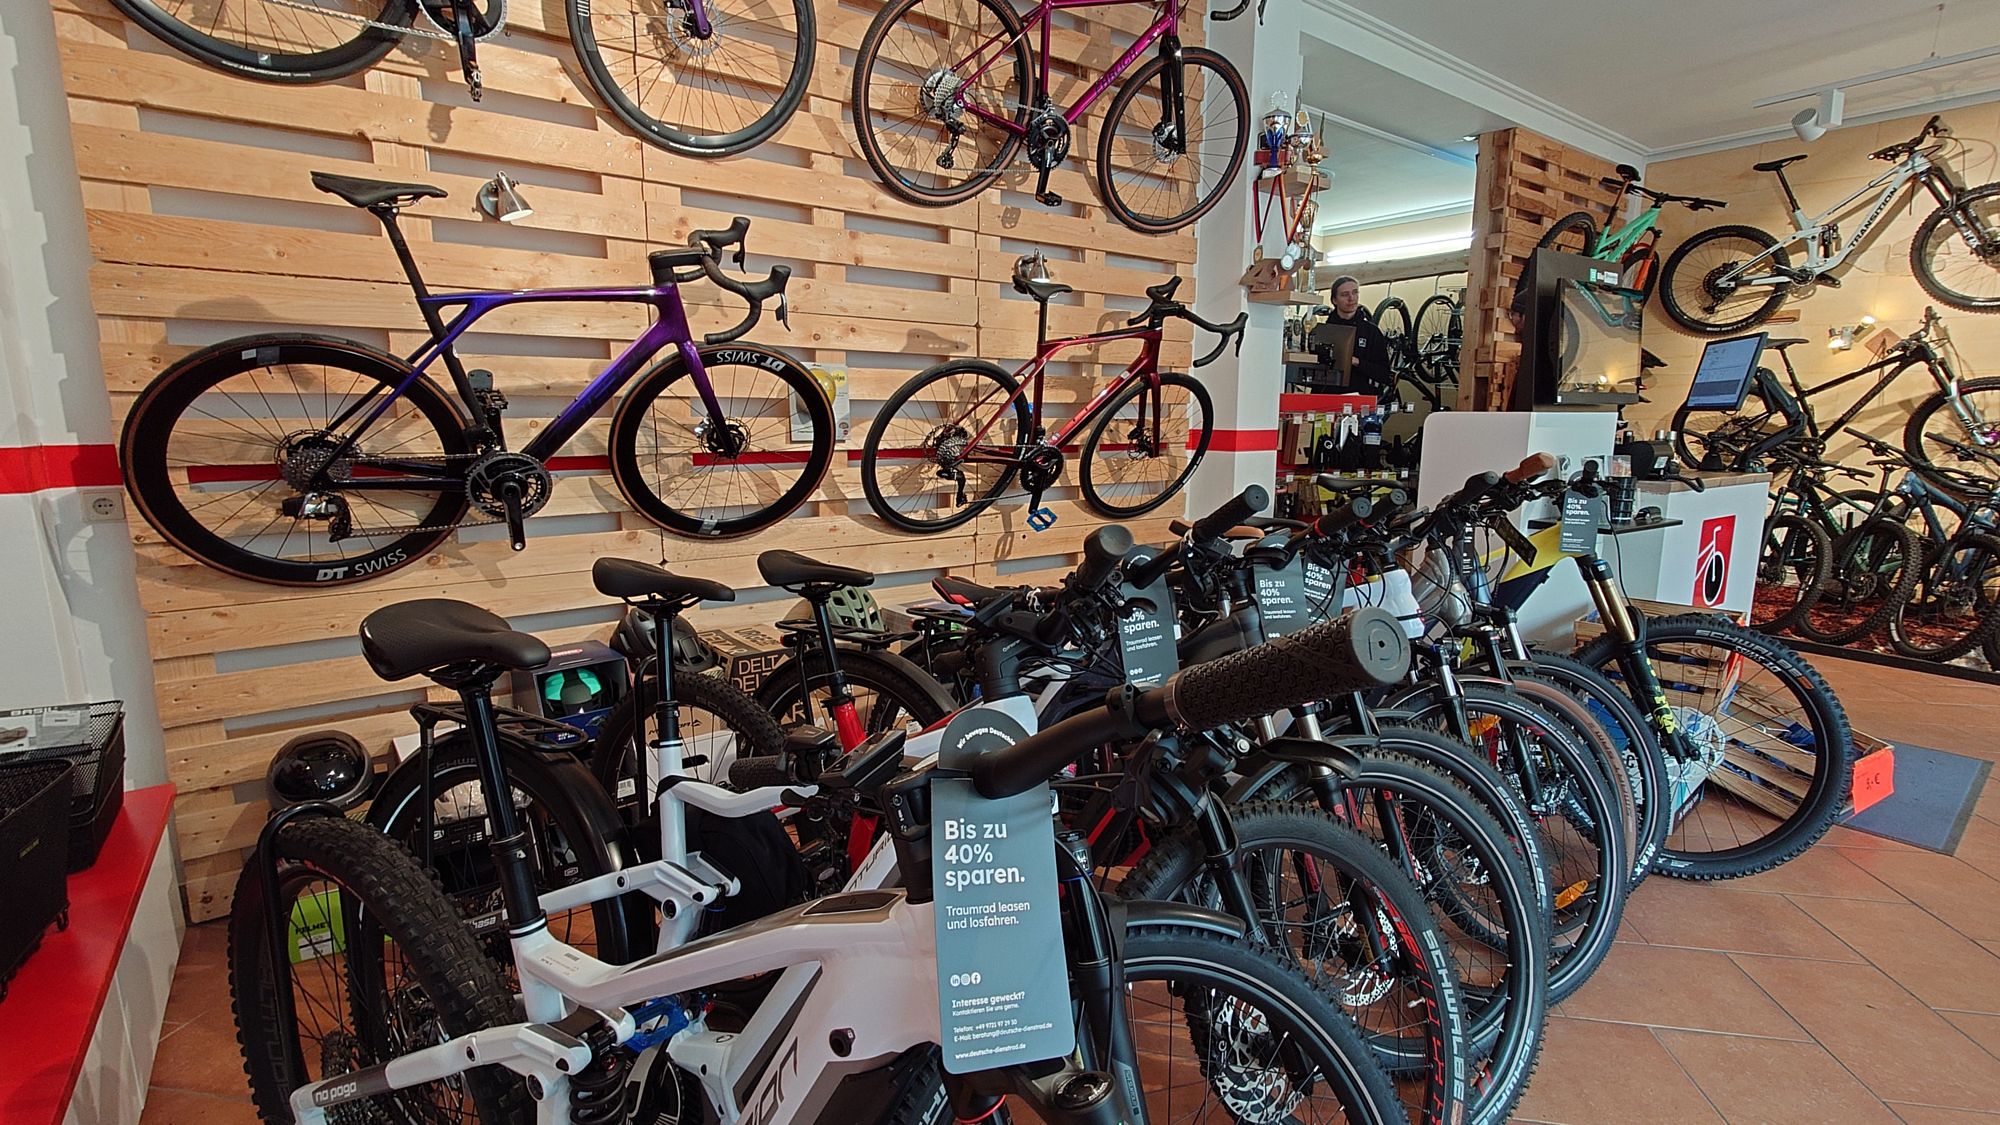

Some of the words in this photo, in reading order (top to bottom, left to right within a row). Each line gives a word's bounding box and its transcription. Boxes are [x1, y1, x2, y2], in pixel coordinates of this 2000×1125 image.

[1847, 187, 1898, 248] TRANSITION
[716, 351, 761, 364] SWISS
[761, 357, 786, 372] DT
[316, 566, 348, 580] DT
[354, 548, 407, 576] SWISS
[1307, 562, 1319, 572] Bis
[1319, 567, 1330, 576] zu
[1259, 578, 1273, 588] Bis
[1274, 580, 1285, 588] zu
[1305, 570, 1324, 581] 40%
[1260, 588, 1280, 597] 40%
[1261, 596, 1294, 607] sparen.
[1123, 619, 1160, 635] sparen.
[1695, 629, 1803, 678] SCHWALBE
[964, 727, 989, 741] bewegen
[944, 817, 977, 841] Bis
[983, 821, 1008, 839] zu
[1495, 786, 1547, 898] SCHWALBE
[944, 843, 993, 865] 40%
[944, 866, 1026, 892] sparen.
[945, 902, 997, 918] Traumrad
[998, 899, 1031, 913] leasen
[946, 917, 968, 931] und
[969, 914, 1020, 929] losfahren.
[951, 996, 989, 1009] Interesse
[989, 990, 1026, 1006] geweckt?
[951, 1007, 986, 1017] Kontaktieren
[1422, 928, 1466, 1101] SCHWALBE
[954, 1043, 1027, 1060] www.deutsche-dienstrad.de
[315, 1089, 330, 1103] no
[330, 1081, 358, 1101] pogo
